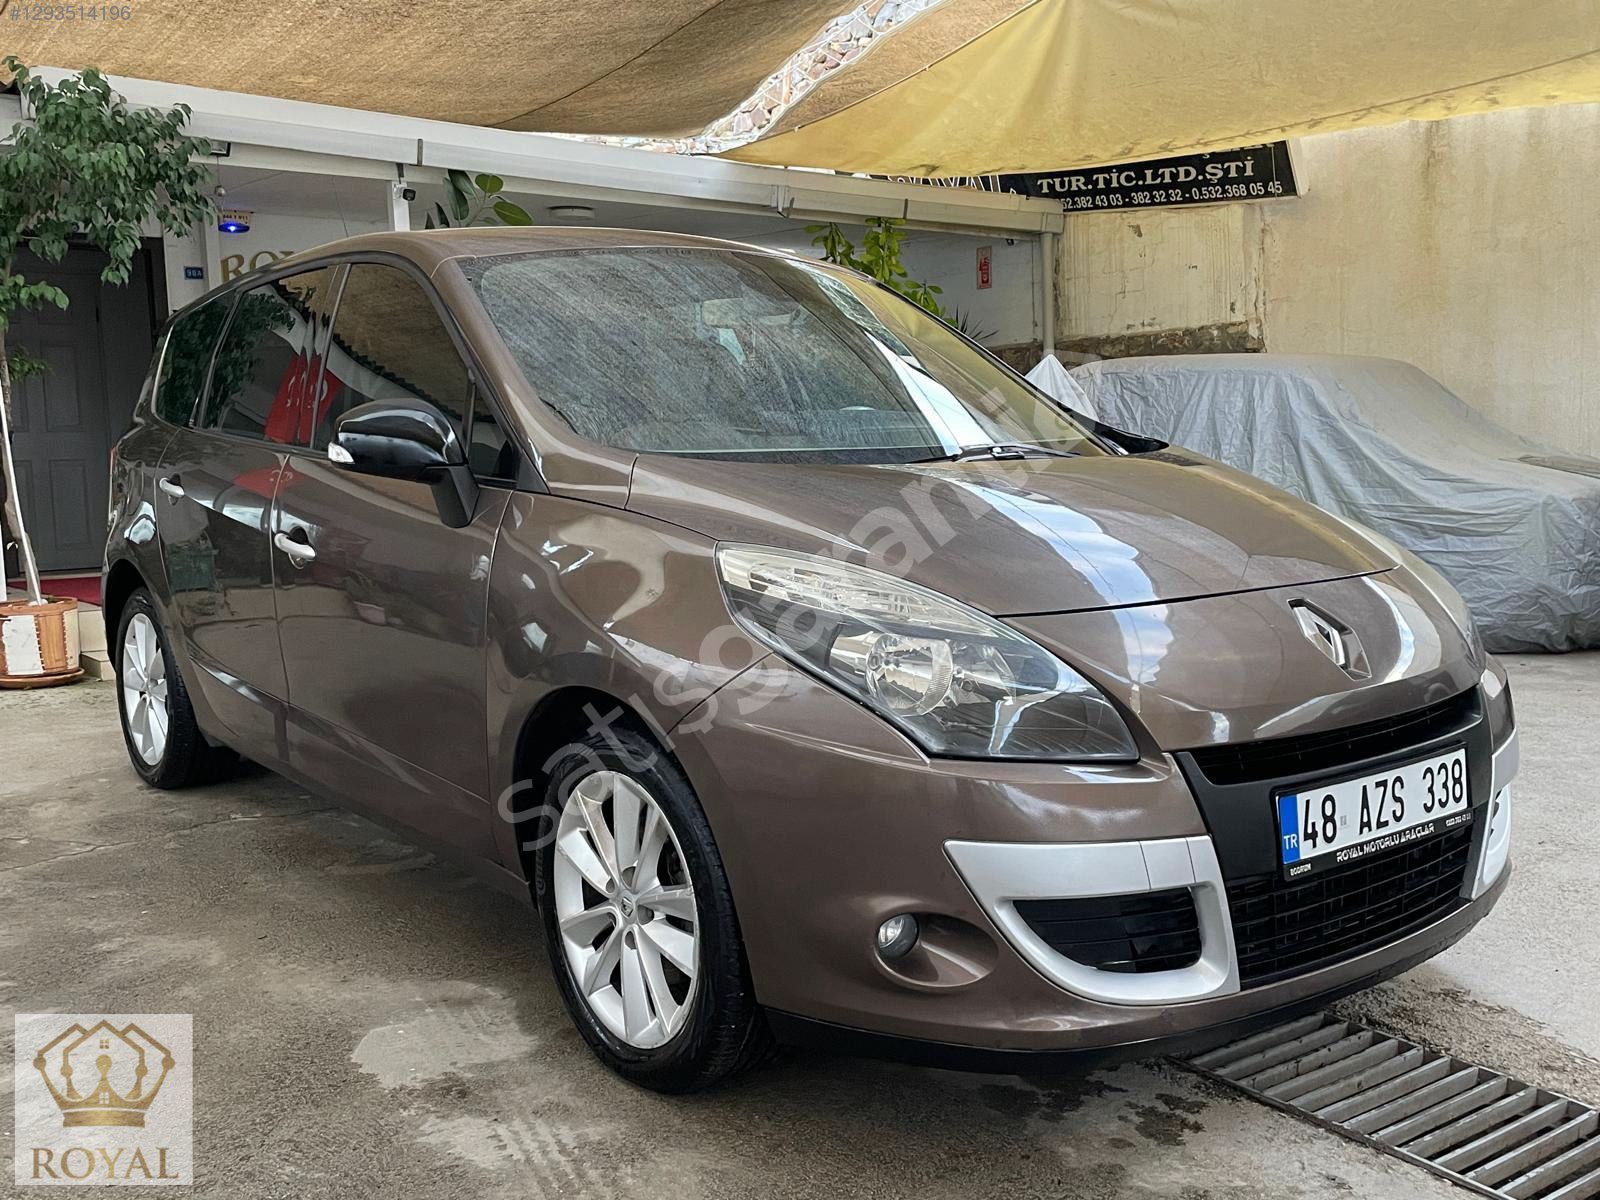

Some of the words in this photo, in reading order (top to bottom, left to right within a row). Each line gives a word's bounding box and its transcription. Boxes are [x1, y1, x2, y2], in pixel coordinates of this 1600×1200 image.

[1037, 156, 1255, 193] TUR.TİC.LTD.ŞTİ
[1057, 195, 1094, 209] 52.382
[1095, 194, 1108, 207] 43
[1109, 193, 1123, 206] 03
[1131, 192, 1152, 205] 382
[1153, 190, 1168, 203] 32
[1169, 189, 1184, 202] 32
[1192, 183, 1247, 201] 0.532.368
[1249, 182, 1265, 196] 05
[1267, 180, 1283, 195] 45
[220, 250, 294, 284] RO
[1302, 794, 1337, 849] 48
[1359, 775, 1405, 835] AZS
[1422, 758, 1464, 814] 338
[1283, 835, 1298, 851] TR
[1336, 847, 1363, 862] ROYAL
